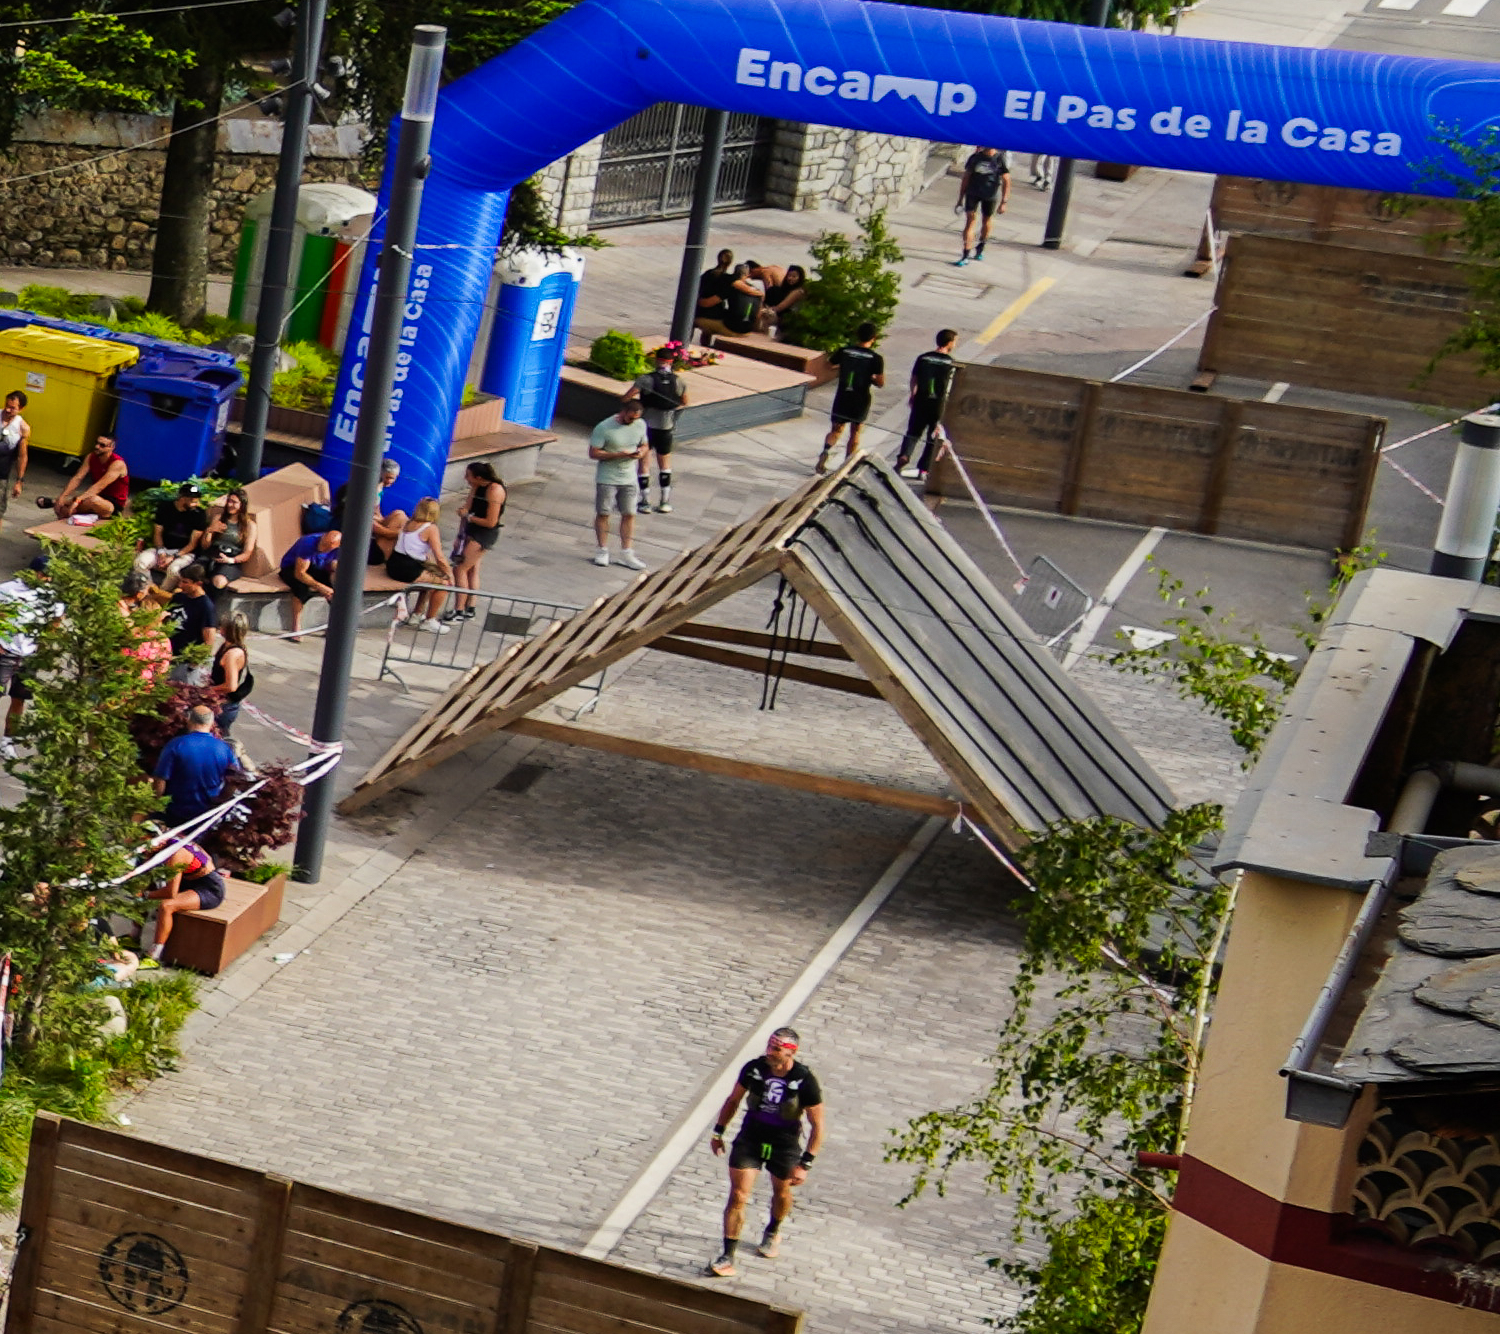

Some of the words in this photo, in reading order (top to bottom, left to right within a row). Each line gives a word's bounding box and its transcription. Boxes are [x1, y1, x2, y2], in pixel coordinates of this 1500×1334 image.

[736, 48, 977, 118] Encamp
[1004, 89, 1044, 122] El
[1057, 95, 1136, 133] Pas
[1151, 105, 1209, 140] de
[1226, 109, 1267, 146] la
[1281, 117, 1401, 157] Casa
[404, 264, 433, 320] Casa
[400, 326, 419, 347] la
